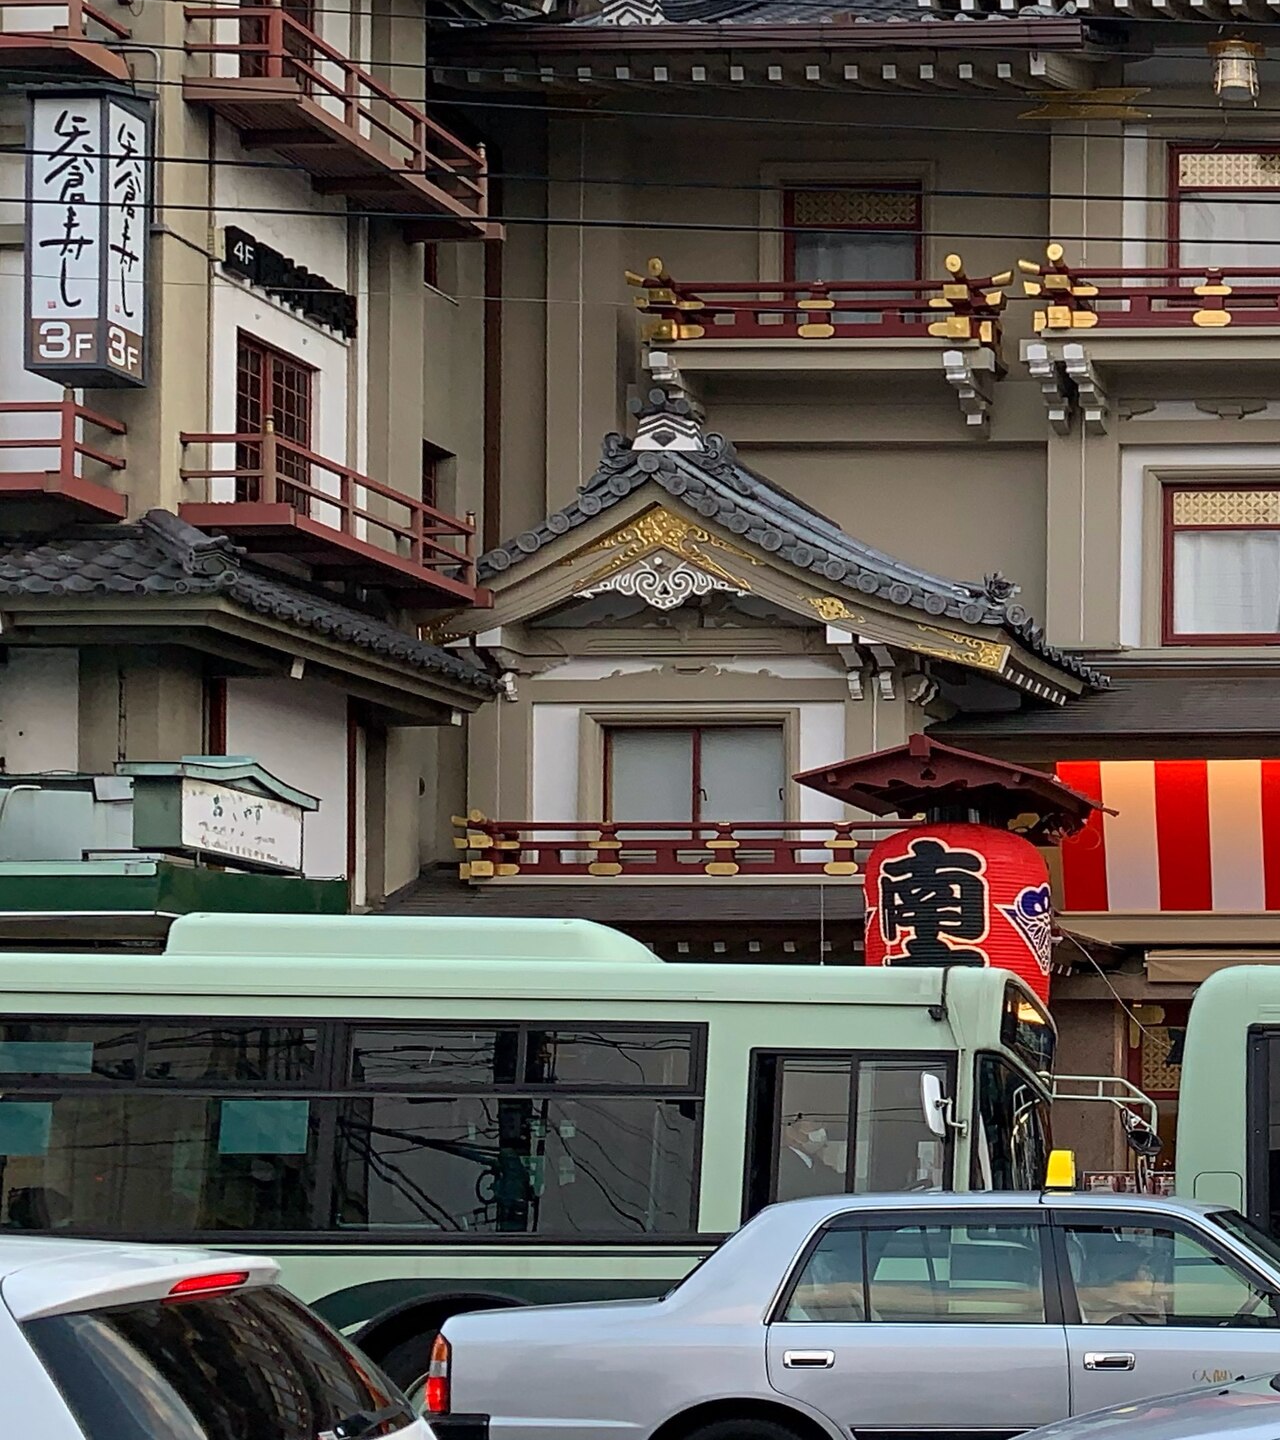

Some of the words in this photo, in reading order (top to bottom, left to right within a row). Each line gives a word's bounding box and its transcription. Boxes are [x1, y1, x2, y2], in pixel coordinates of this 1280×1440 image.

[233, 241, 254, 264] 4F
[38, 321, 94, 359] 3F
[108, 326, 139, 371] 3F
[879, 837, 990, 966] 南
